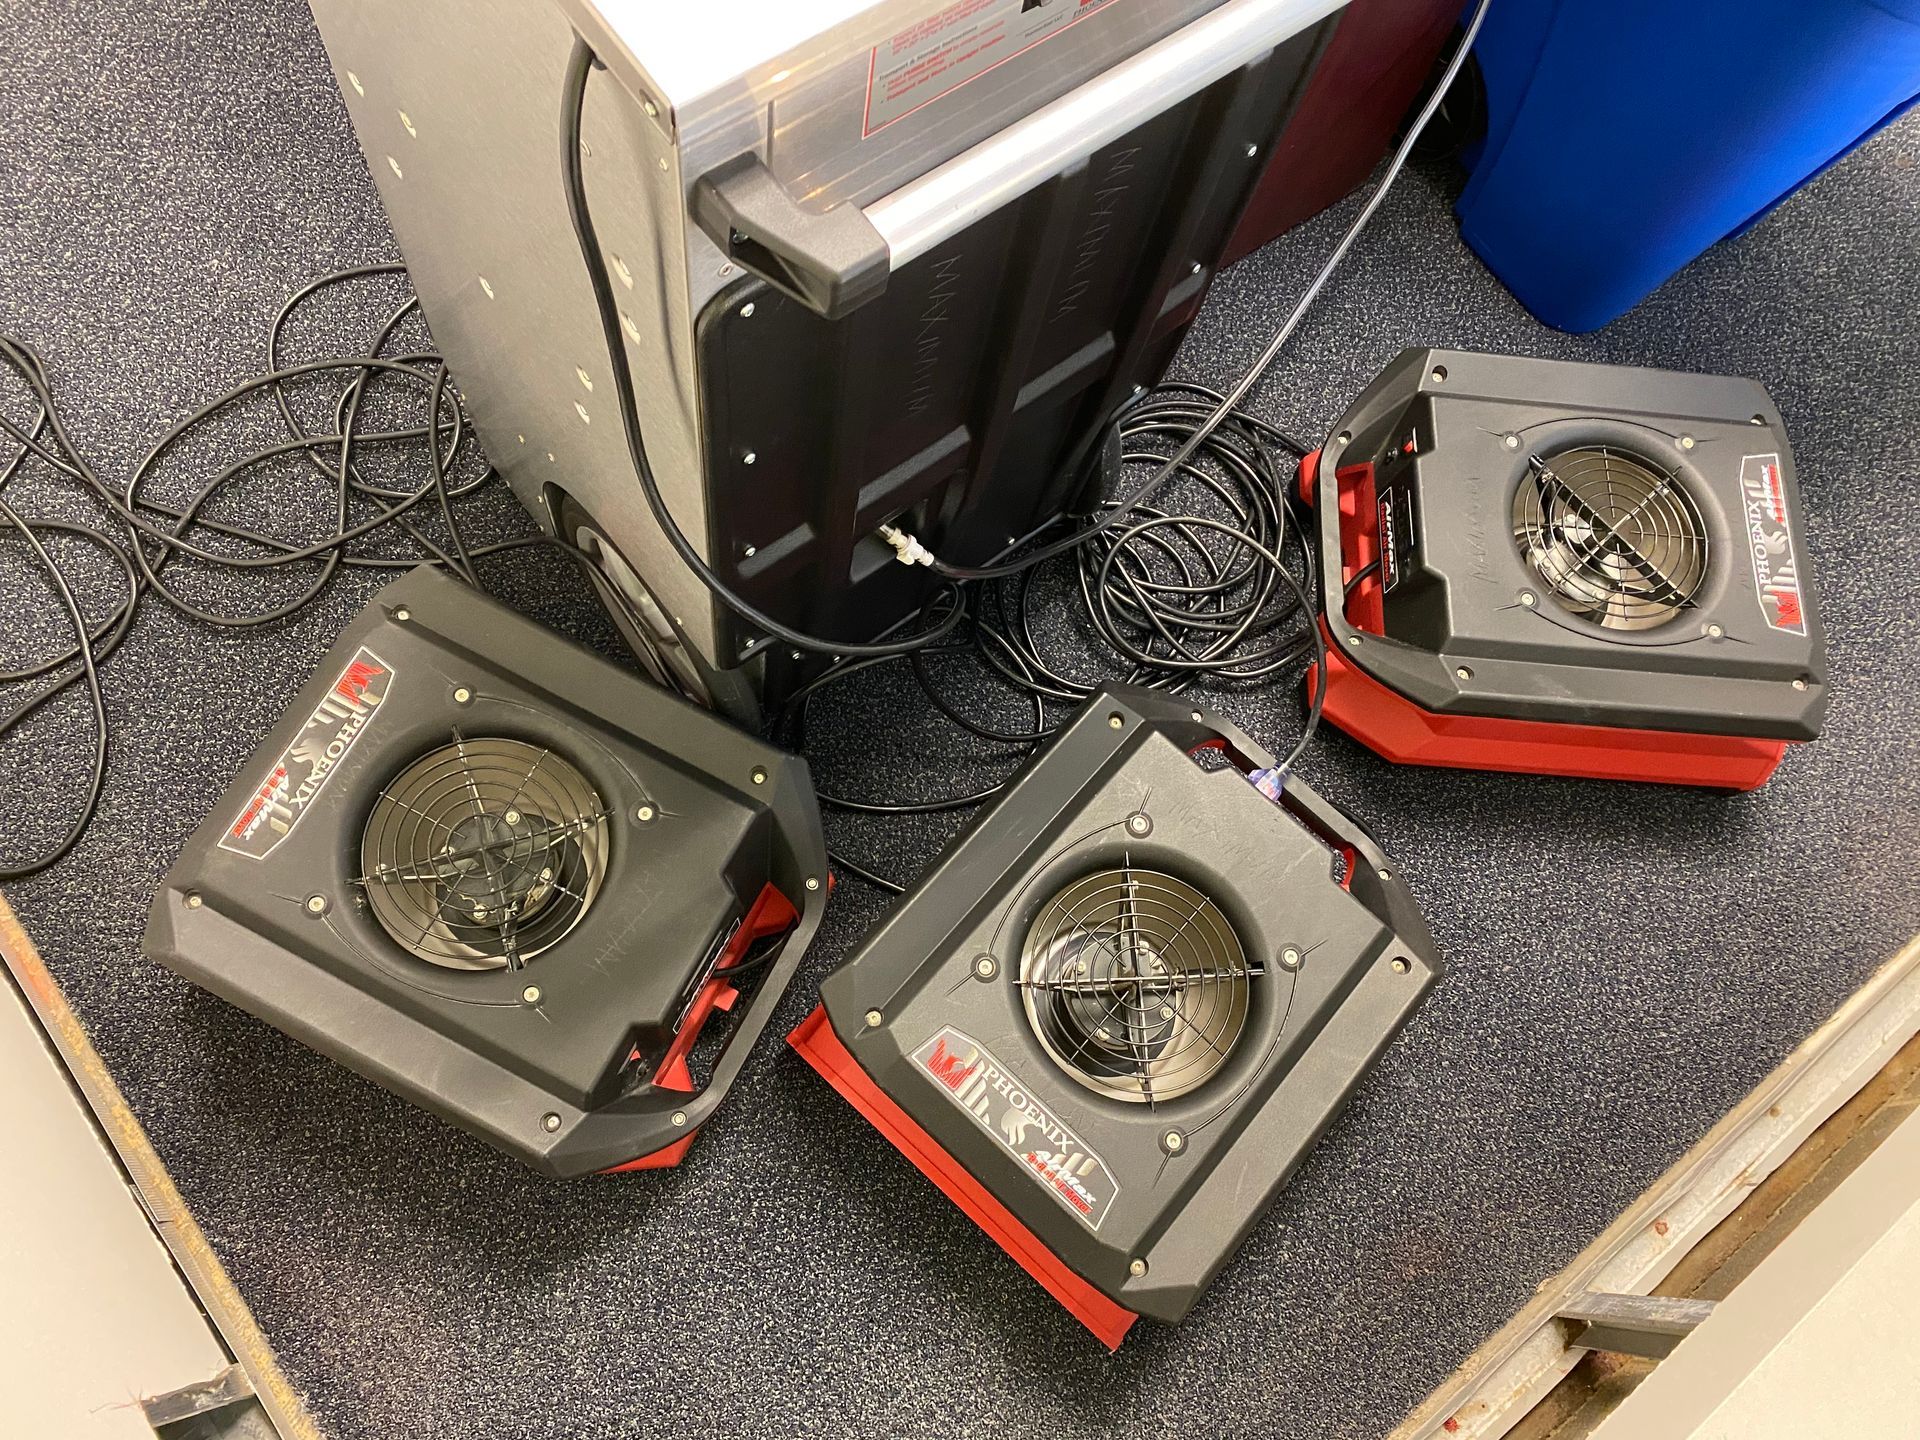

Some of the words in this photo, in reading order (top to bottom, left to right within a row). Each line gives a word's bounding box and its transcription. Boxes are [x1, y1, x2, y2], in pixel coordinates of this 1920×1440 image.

[1385, 501, 1394, 574] AirMax
[1746, 500, 1772, 586] PHOENIX
[288, 710, 368, 810] PHOENIX
[982, 1064, 1075, 1154] PHOENIX
[1033, 1151, 1096, 1204] AirMax
